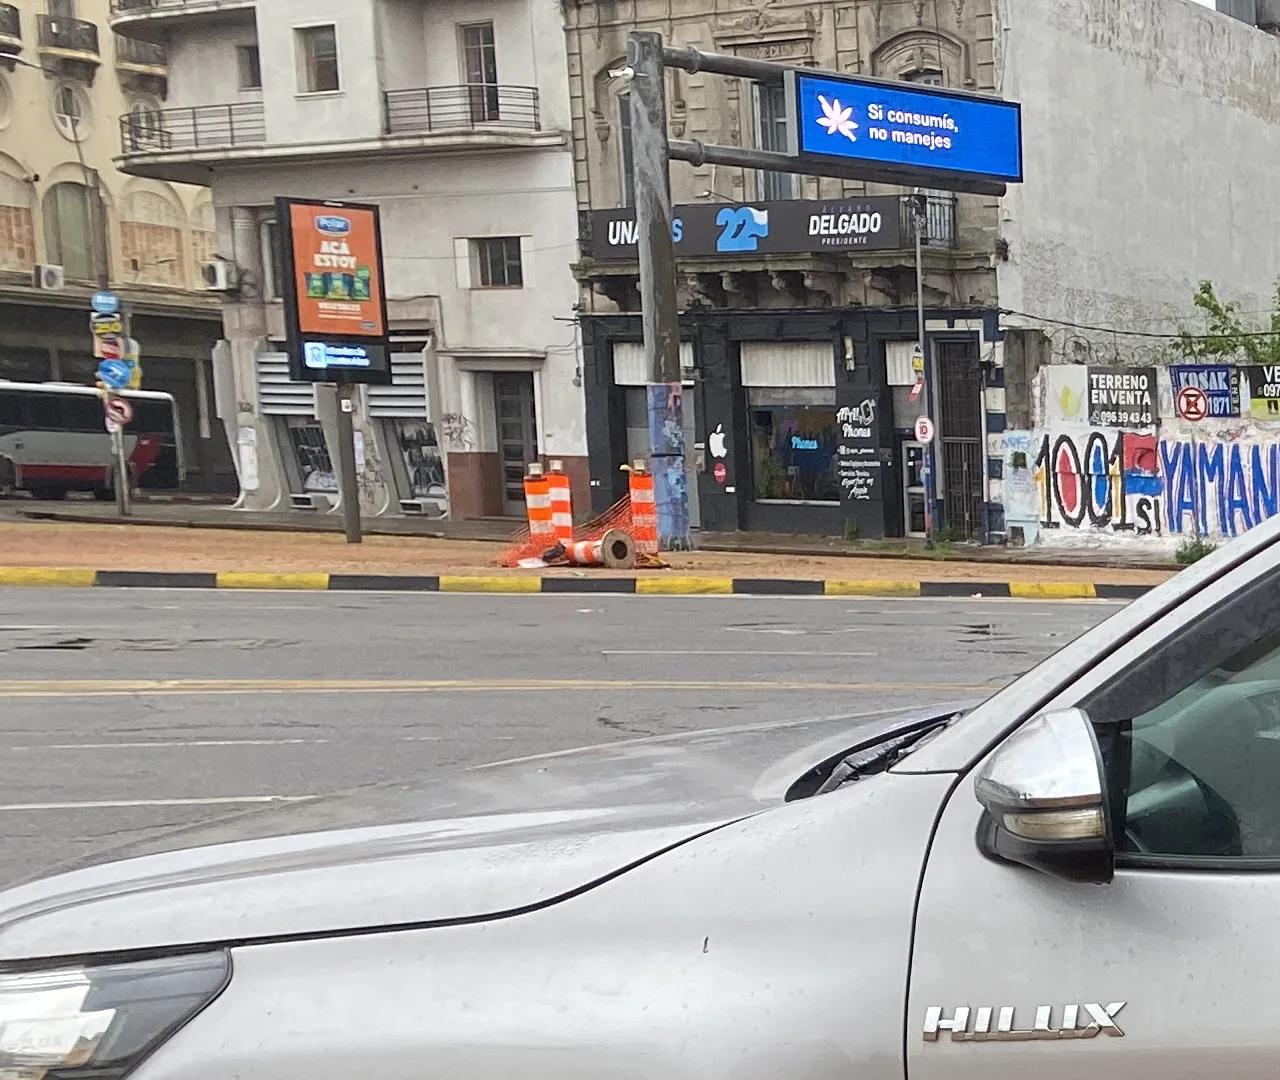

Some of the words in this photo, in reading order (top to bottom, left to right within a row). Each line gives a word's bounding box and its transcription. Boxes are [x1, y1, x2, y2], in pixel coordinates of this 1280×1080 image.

[868, 104, 883, 120] Si
[887, 110, 959, 133] consumís,
[870, 128, 887, 141] no
[892, 130, 951, 150] manejes
[716, 207, 762, 252] 22
[808, 212, 882, 236] DELGADO
[821, 236, 867, 246] PRESIDENTE
[313, 254, 357, 269] ESTOY
[1091, 374, 1148, 390] TERRENO
[1091, 390, 1108, 404] EN
[1110, 390, 1151, 406] VENTA
[1118, 411, 1128, 423] 39
[1130, 411, 1140, 423] 43
[1141, 412, 1151, 424] 43
[1035, 431, 1134, 531] 1001
[923, 1001, 1127, 1041] HILUX
